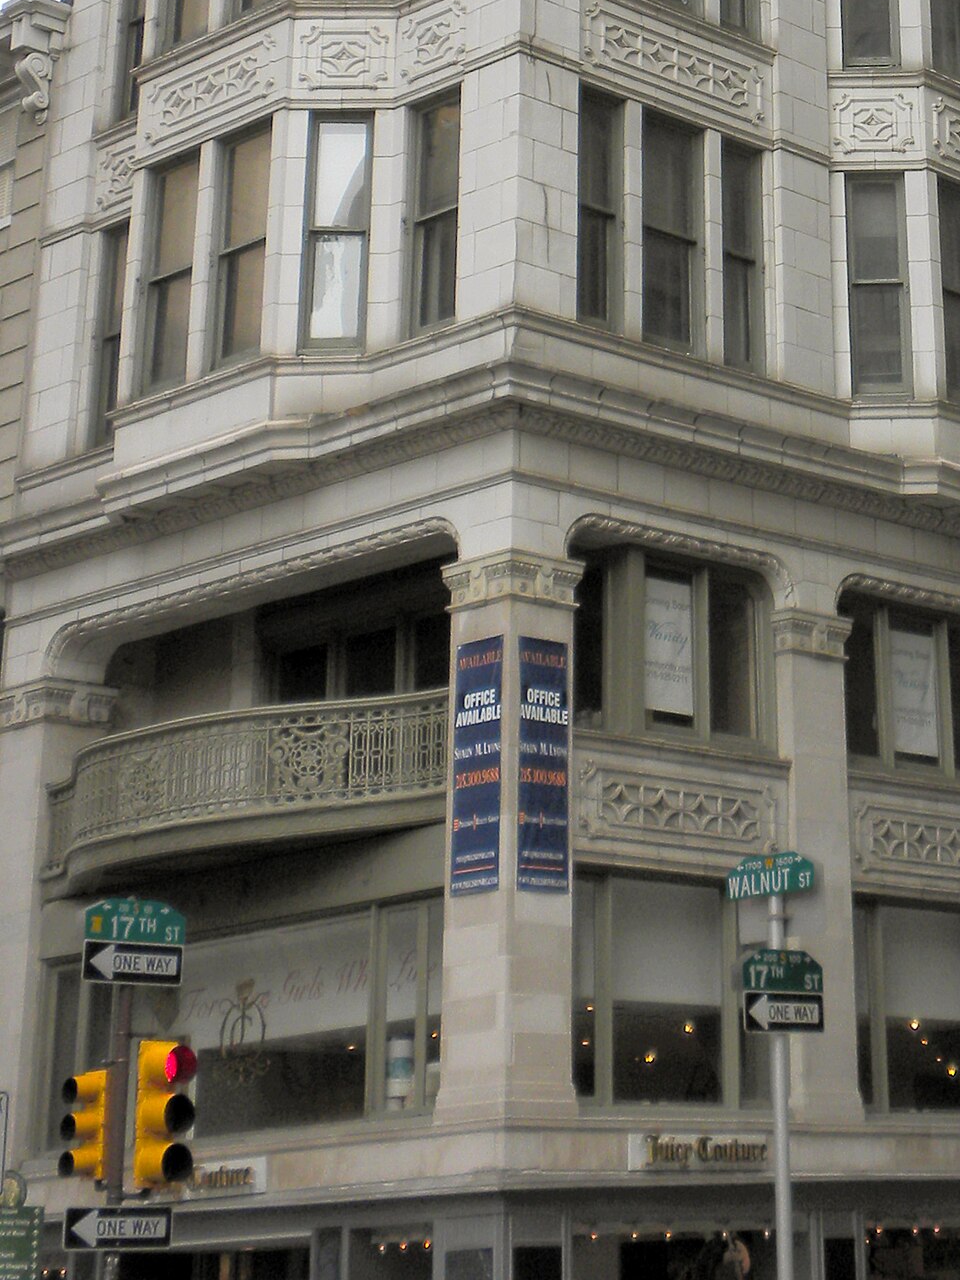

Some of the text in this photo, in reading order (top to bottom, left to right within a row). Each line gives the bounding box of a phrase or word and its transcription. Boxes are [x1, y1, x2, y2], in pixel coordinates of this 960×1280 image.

[464, 689, 496, 709] OFFICE
[527, 688, 560, 708] OFFICE
[456, 704, 501, 728] AVAILABLE
[520, 704, 568, 725] AVAILABLE
[728, 867, 811, 899] WALNUT ST
[111, 915, 181, 942] 17TH ST
[113, 955, 172, 973] ONE WAY
[749, 965, 819, 990] 17TH ST
[769, 1005, 815, 1020] ONE WAY
[645, 1134, 768, 1168] Juicy Couture
[97, 1221, 160, 1237] ONE WAY
